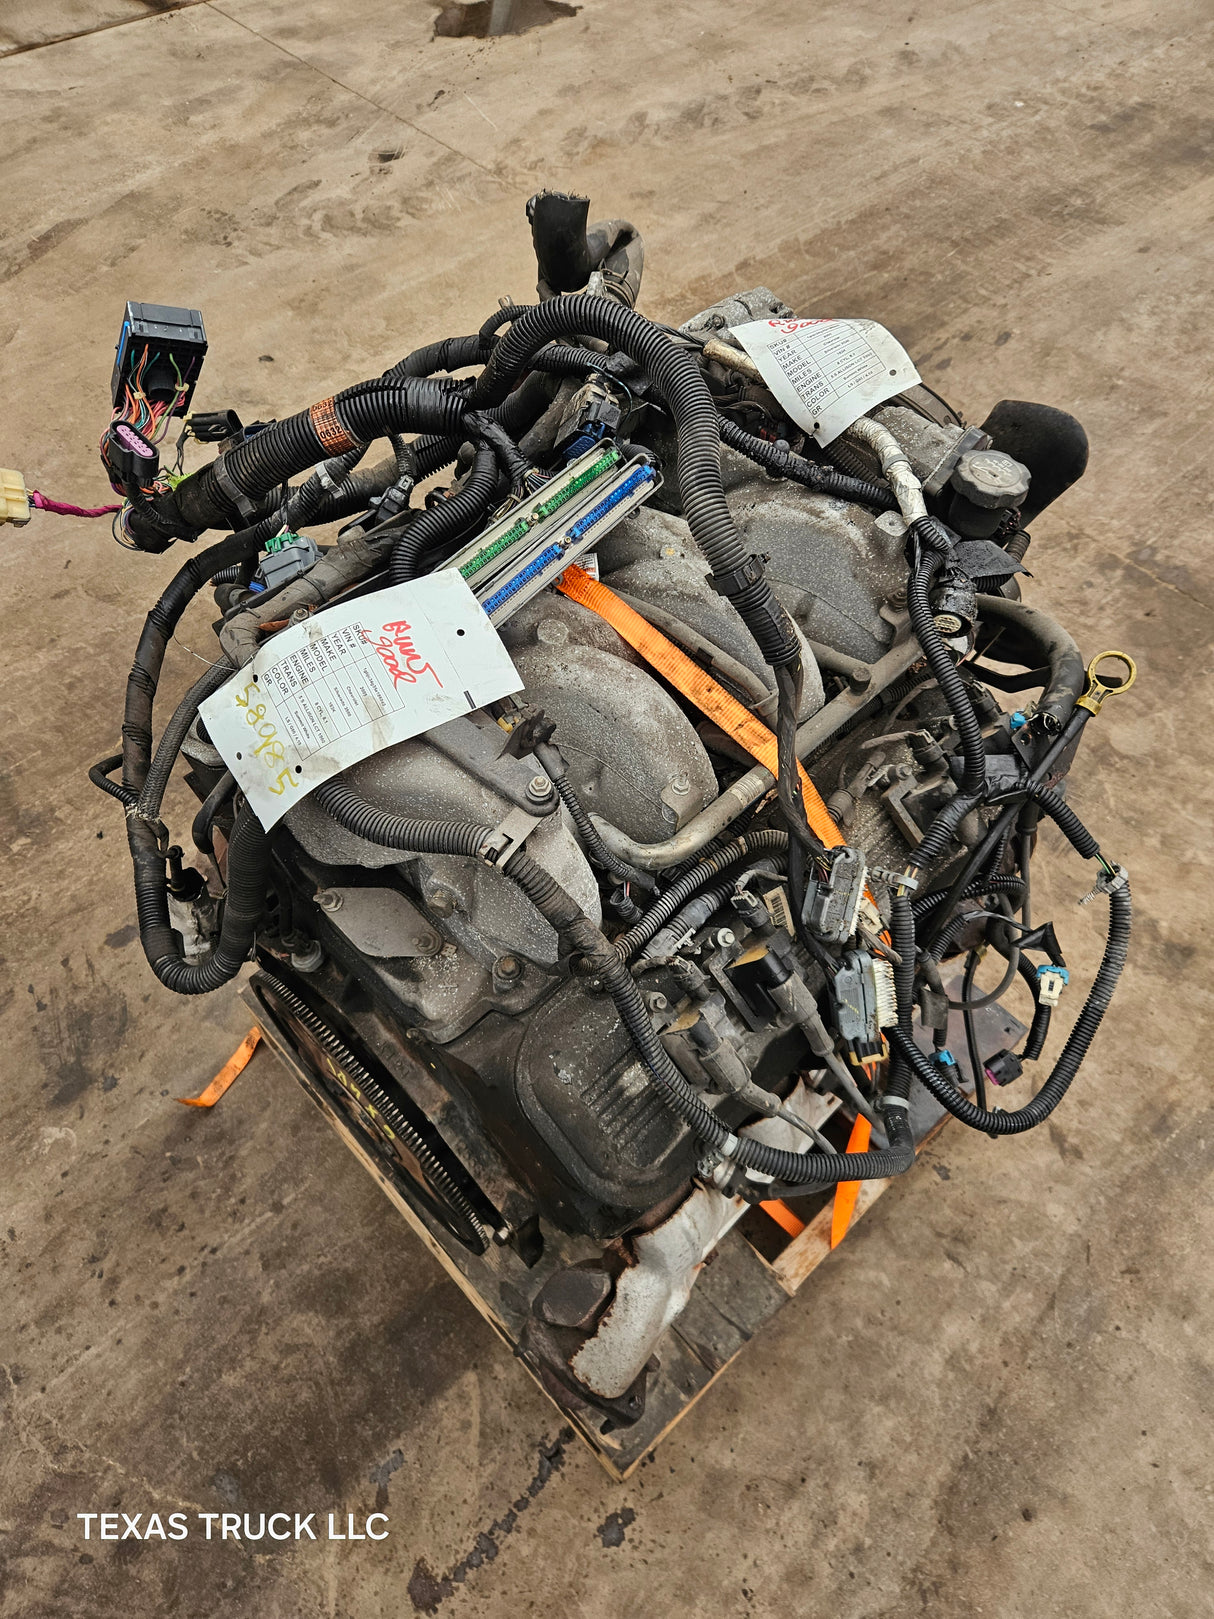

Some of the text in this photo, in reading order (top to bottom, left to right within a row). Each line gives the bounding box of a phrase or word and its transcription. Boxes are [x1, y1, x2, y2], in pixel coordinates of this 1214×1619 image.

[770, 338, 787, 349] SKU#
[774, 348, 786, 356] VIN
[778, 350, 797, 362] YEAR
[782, 355, 802, 370] MAKE
[786, 360, 812, 378] MODEL
[792, 368, 812, 385] MILES
[796, 372, 822, 392] ENGINE
[801, 382, 824, 400] TRANS
[806, 387, 830, 408] COLOR
[812, 405, 822, 416] GR
[320, 426, 342, 439] 0632
[332, 634, 346, 655] YEAR
[342, 629, 353, 642] VIN
[352, 624, 367, 645] SKU#
[310, 644, 328, 672] MODEL
[321, 638, 336, 661] MAKE
[290, 655, 309, 684] ENGINE
[300, 649, 316, 673] MILES
[264, 674, 272, 686] GR
[272, 668, 289, 695] COLOR
[280, 661, 297, 687] TRANS
[346, 686, 359, 706] Chevrolet
[303, 703, 314, 724] ALLISON
[236, 682, 299, 795] 58985
